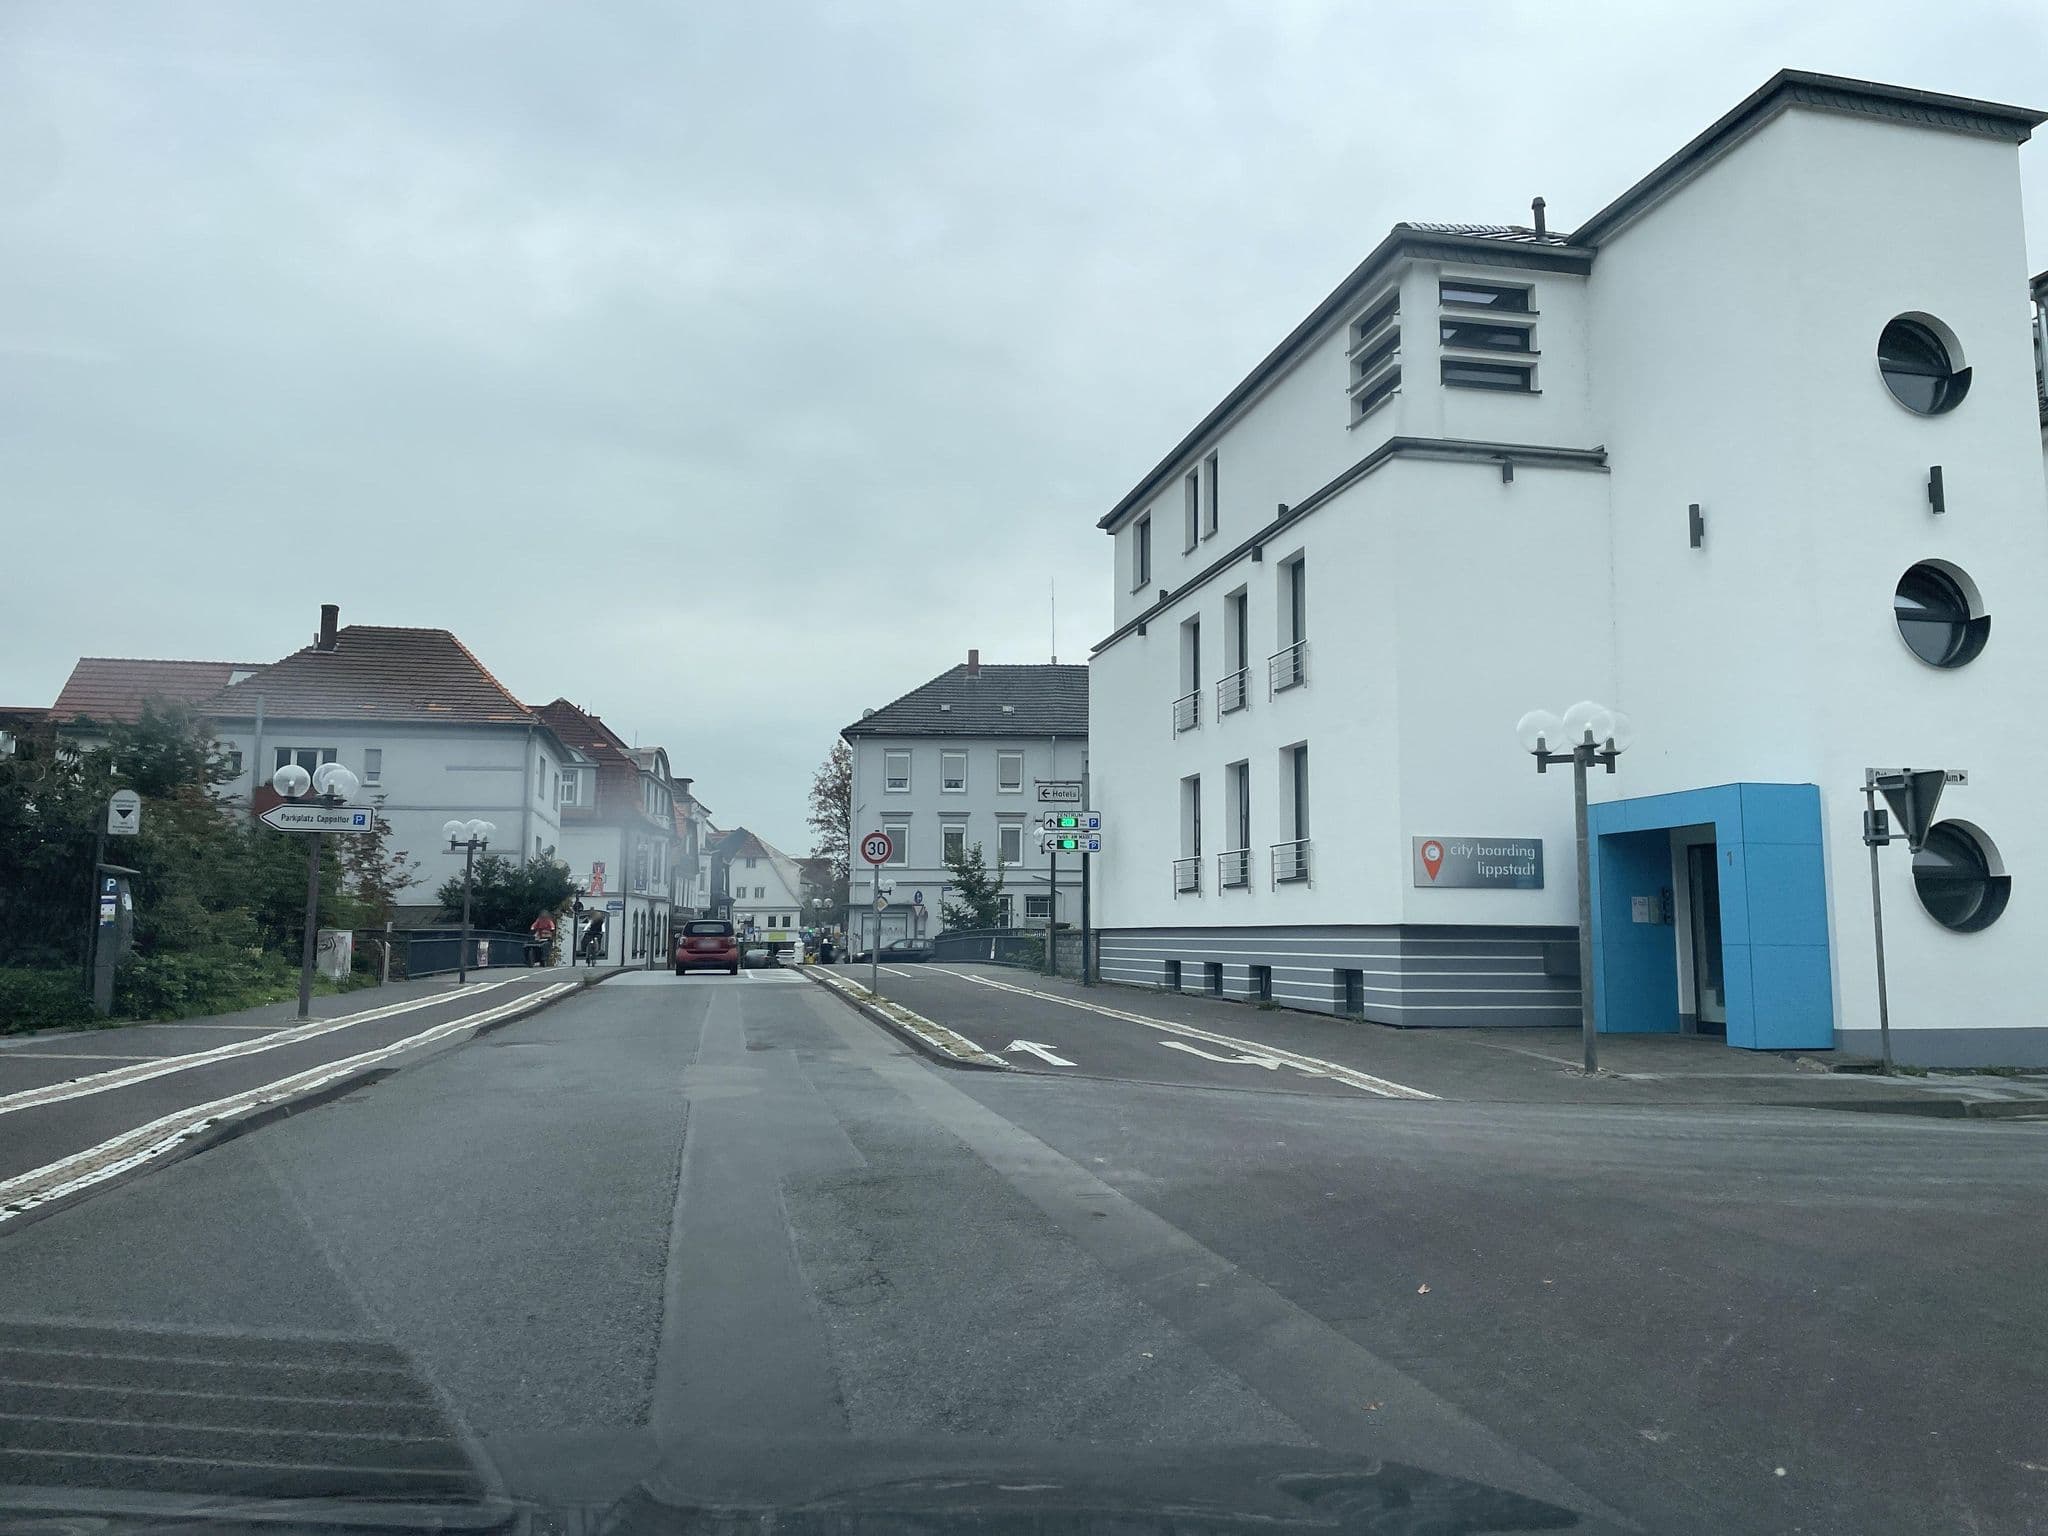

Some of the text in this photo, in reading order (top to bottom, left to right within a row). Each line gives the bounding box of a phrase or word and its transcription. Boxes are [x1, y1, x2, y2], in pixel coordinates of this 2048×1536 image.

[1052, 790, 1077, 798] Hotels
[281, 813, 314, 824] Parkplatz
[867, 841, 886, 856] 30
[1450, 843, 1536, 860] city boarding
[1726, 850, 1733, 866] 1
[1477, 861, 1536, 878] lippstadt
[106, 878, 117, 892] P
